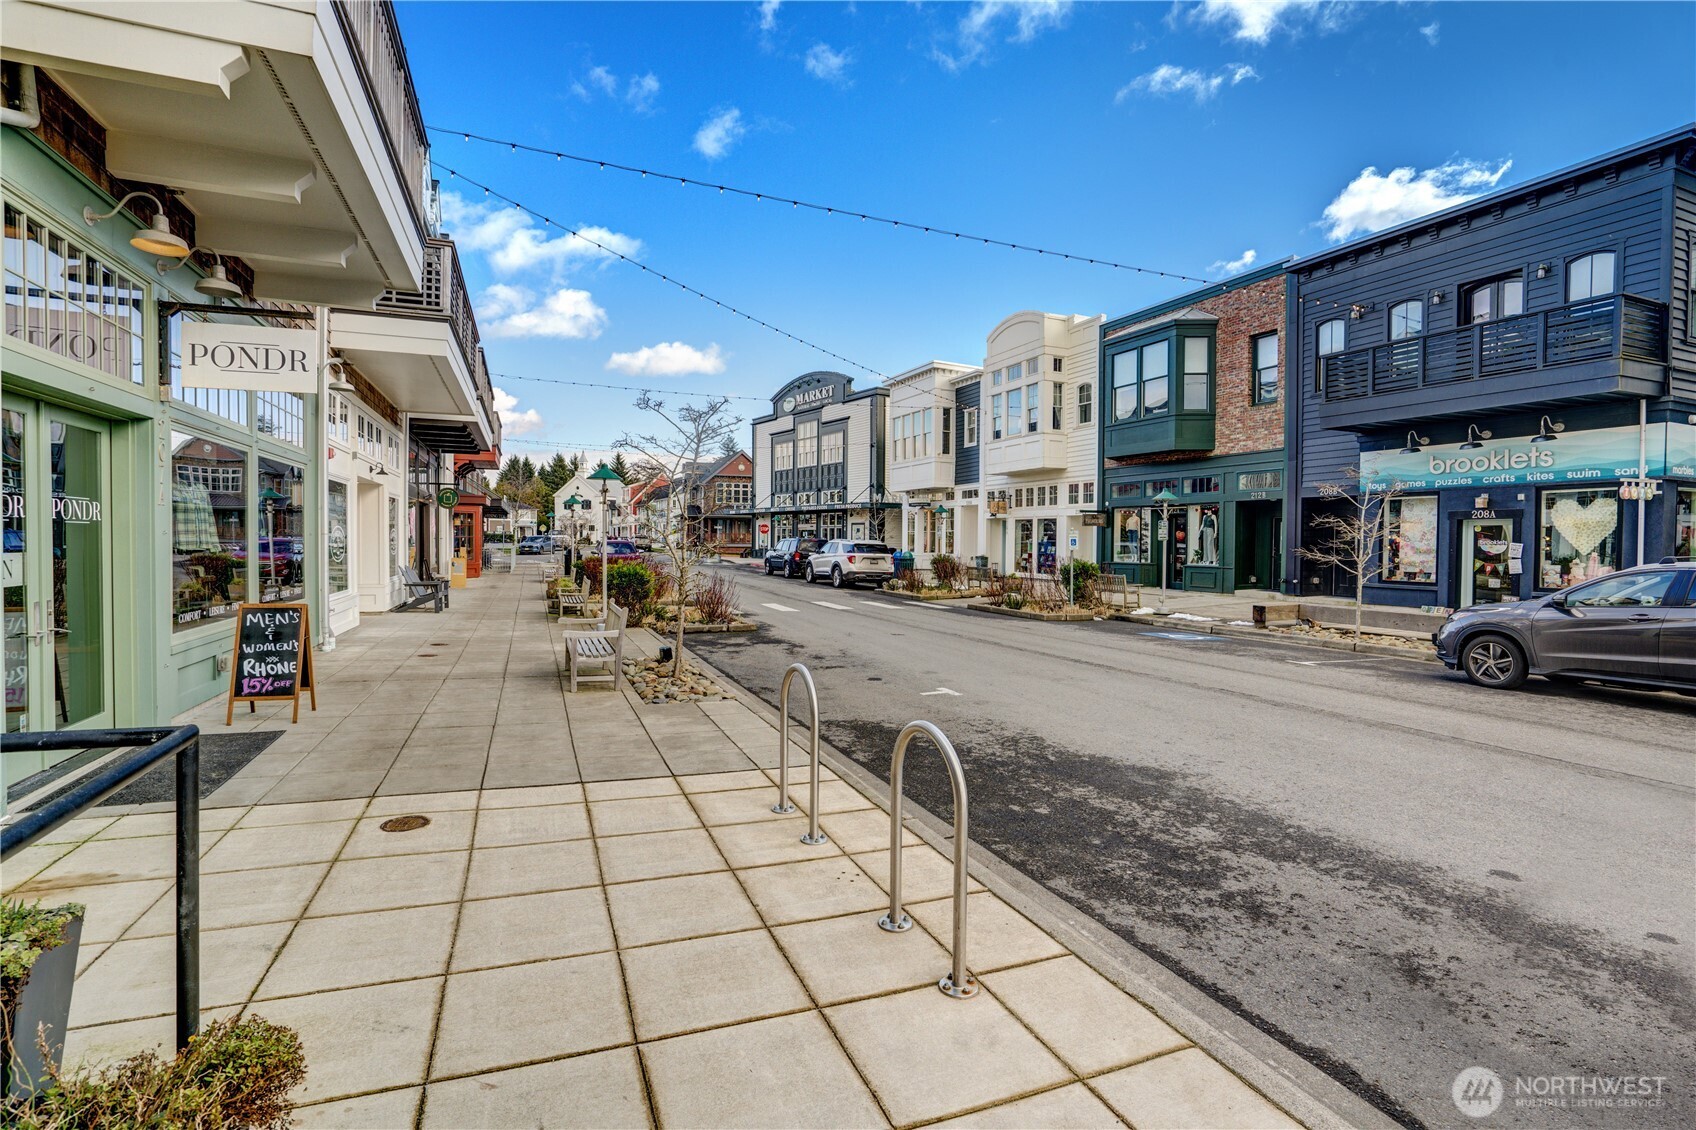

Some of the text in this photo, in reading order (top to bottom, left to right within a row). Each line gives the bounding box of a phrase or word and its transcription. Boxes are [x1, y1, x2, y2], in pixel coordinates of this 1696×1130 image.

[188, 341, 310, 373] PONDR
[796, 385, 835, 405] MARKET
[1429, 446, 1554, 475] brooklets
[1672, 465, 1694, 475] marbles
[1368, 482, 1386, 491] toys
[1395, 480, 1426, 489] games
[1435, 477, 1472, 487] puzzles
[1483, 474, 1515, 483] crafts
[1526, 472, 1554, 481] kites
[1567, 469, 1601, 479] swim
[52, 498, 101, 521] PONDR
[1471, 510, 1496, 519] 208A
[179, 610, 202, 623] COMFORT
[209, 605, 225, 616] LEISURE
[246, 610, 300, 627] MEN'S
[242, 640, 299, 653] WOMEN'S
[243, 658, 297, 676] RHONE
[241, 677, 274, 696] 15%
